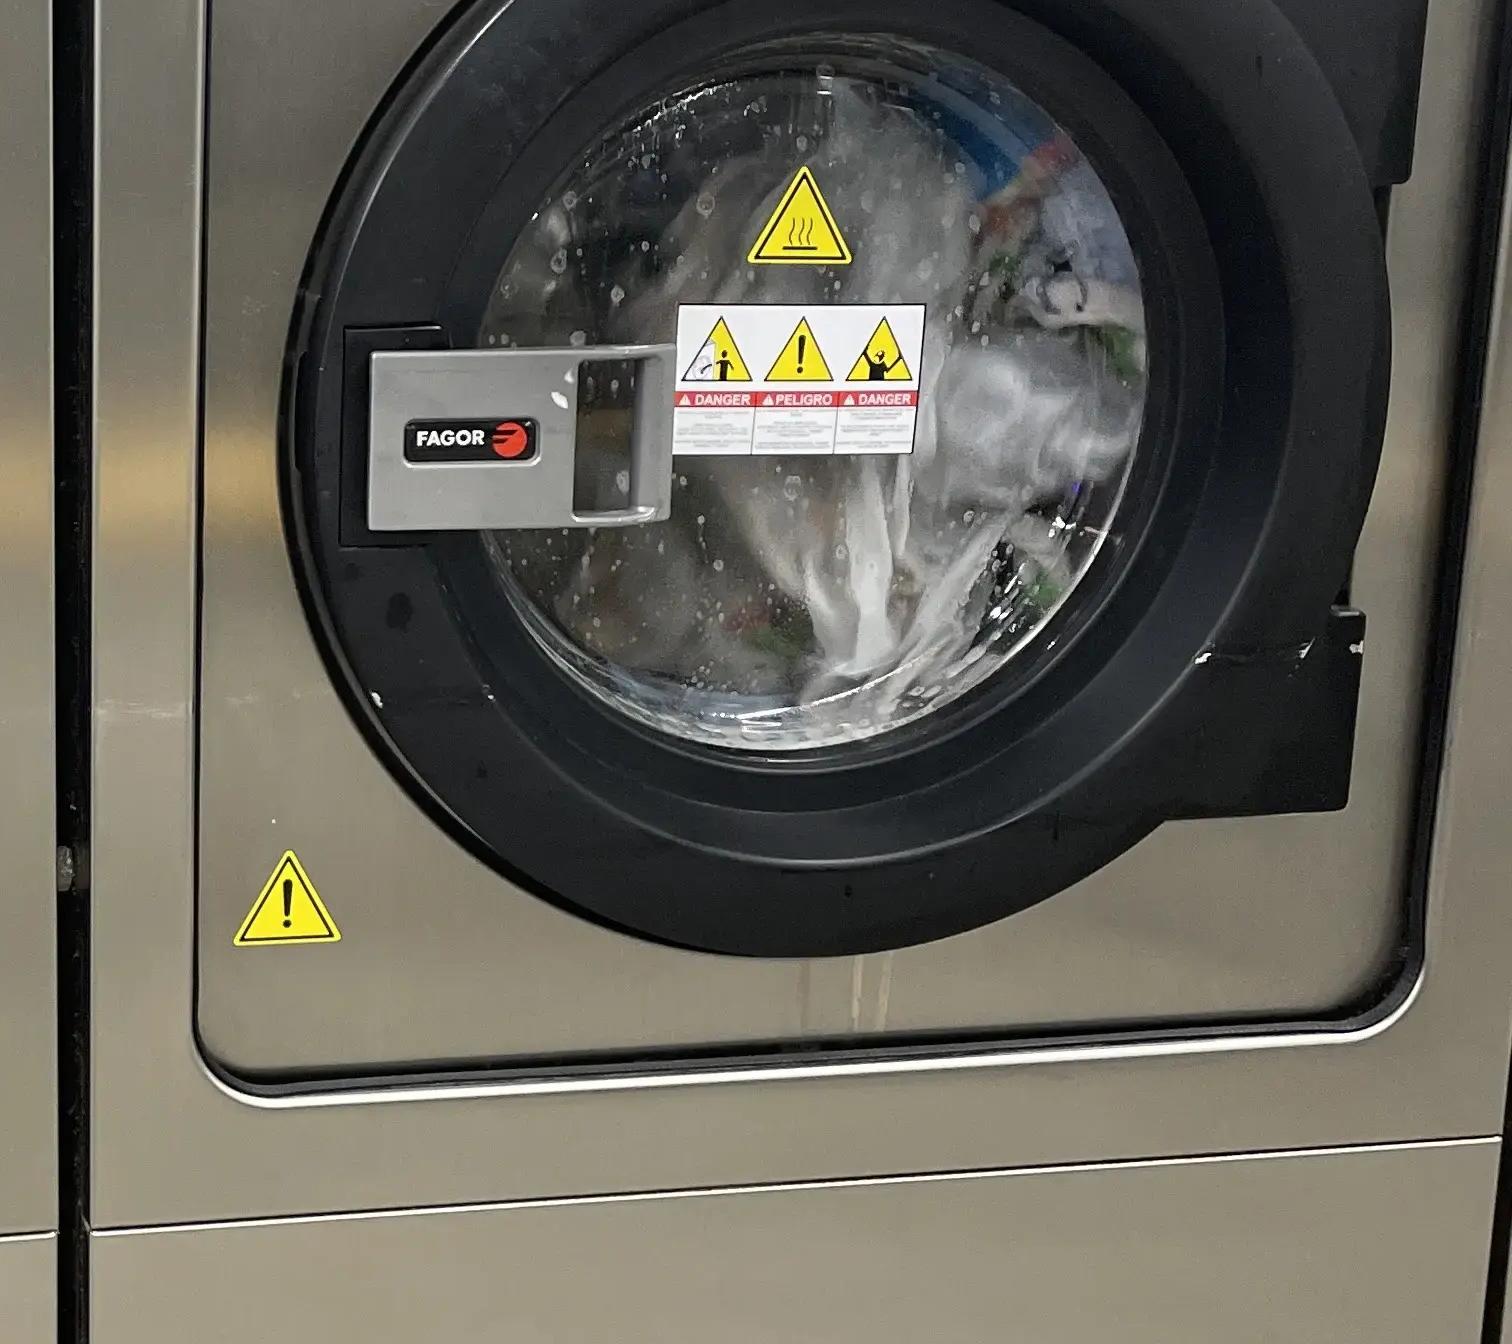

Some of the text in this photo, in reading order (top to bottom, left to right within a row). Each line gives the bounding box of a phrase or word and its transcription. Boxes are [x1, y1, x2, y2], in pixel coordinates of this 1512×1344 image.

[694, 393, 751, 406] DANGER
[775, 393, 833, 406] PELIGRO
[858, 393, 912, 405] DANGER
[416, 429, 485, 447] FAGOR
